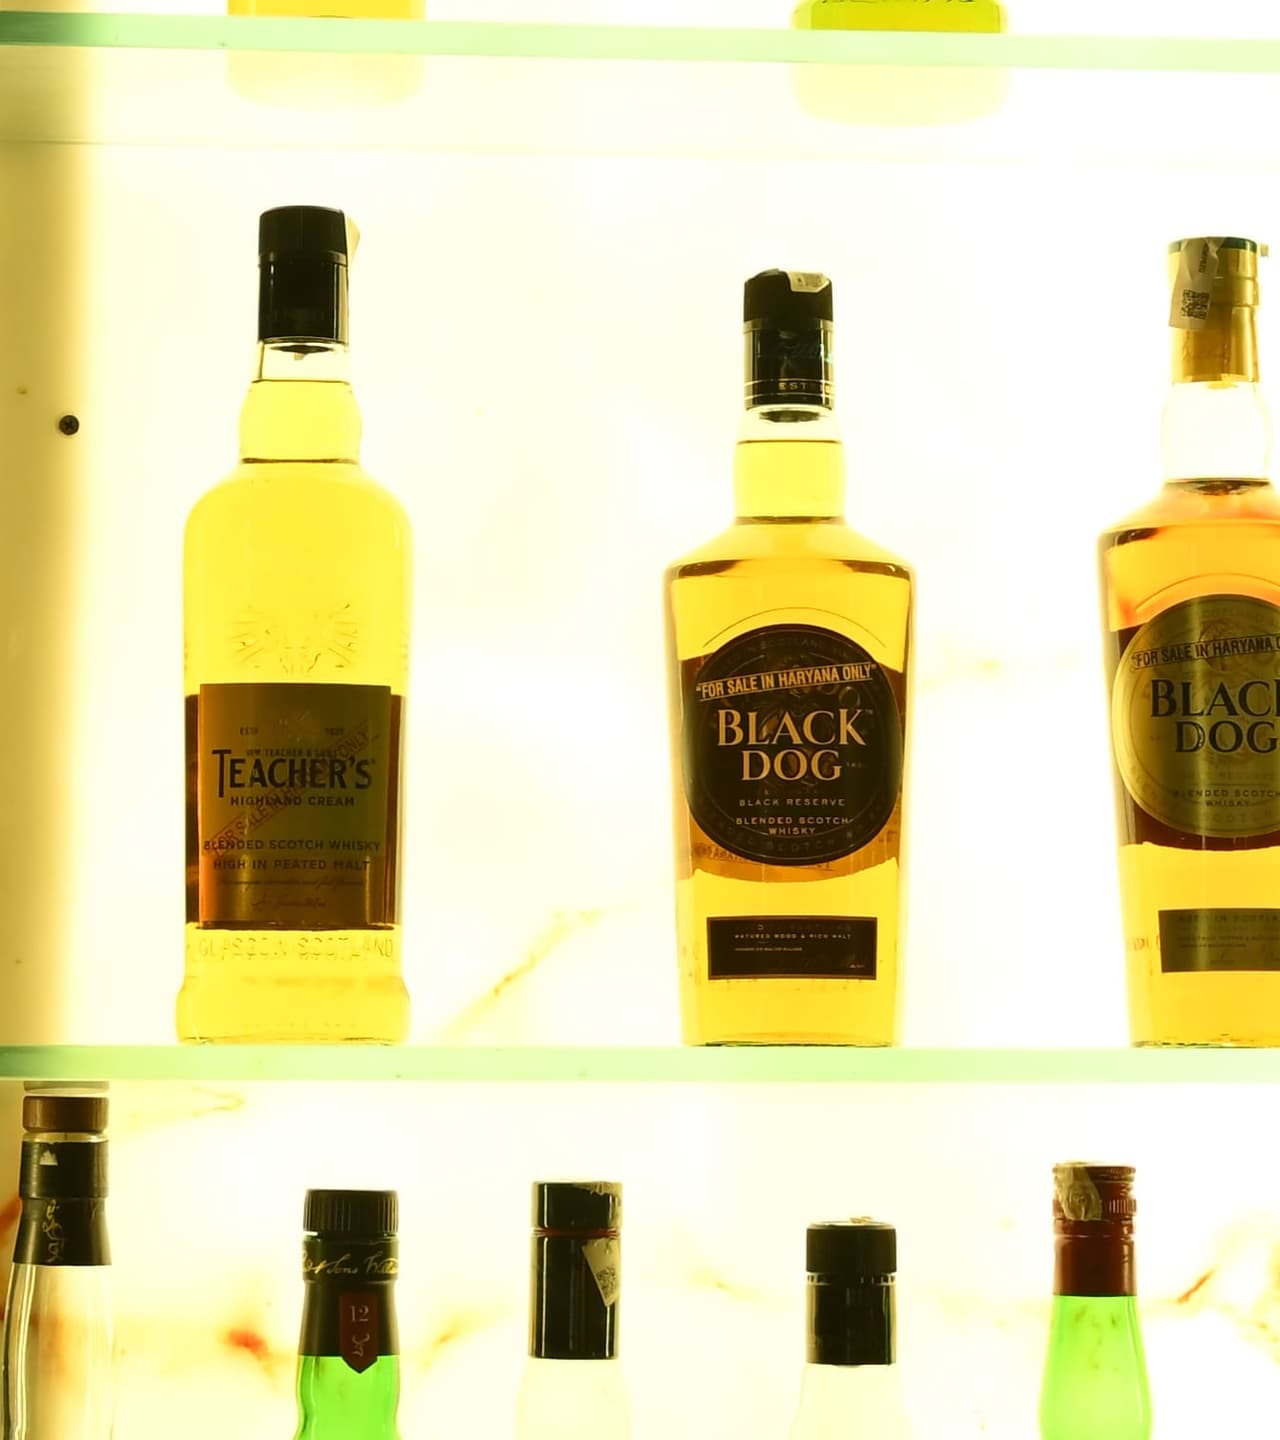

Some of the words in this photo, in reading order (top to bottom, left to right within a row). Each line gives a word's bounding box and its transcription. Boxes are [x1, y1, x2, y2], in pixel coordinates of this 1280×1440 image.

[1160, 645, 1193, 662] SALE
[1195, 642, 1210, 658] IN
[1212, 636, 1275, 658] HARYANA
[726, 677, 759, 695] SALE
[761, 674, 775, 689] IN
[778, 667, 841, 688] HARYANA
[716, 708, 868, 747] BLACK
[1174, 720, 1280, 755] DOG
[211, 748, 374, 799] TEACHER'S
[740, 748, 843, 782] DOG
[230, 795, 302, 808] HIGHLAND
[307, 795, 356, 809] CREAM
[738, 797, 780, 808] BLACK
[786, 797, 846, 808] RESERVE
[735, 816, 794, 826] BLENDED
[798, 816, 850, 826] SCOTCH
[768, 826, 817, 837] WHISKY
[203, 839, 268, 852] BLENDED
[269, 839, 324, 852] SCOTCH
[328, 839, 381, 853] WHISKY
[214, 859, 246, 872] HIGH
[251, 859, 267, 871] IN
[272, 859, 327, 872] PEATED
[332, 859, 368, 872] MALT
